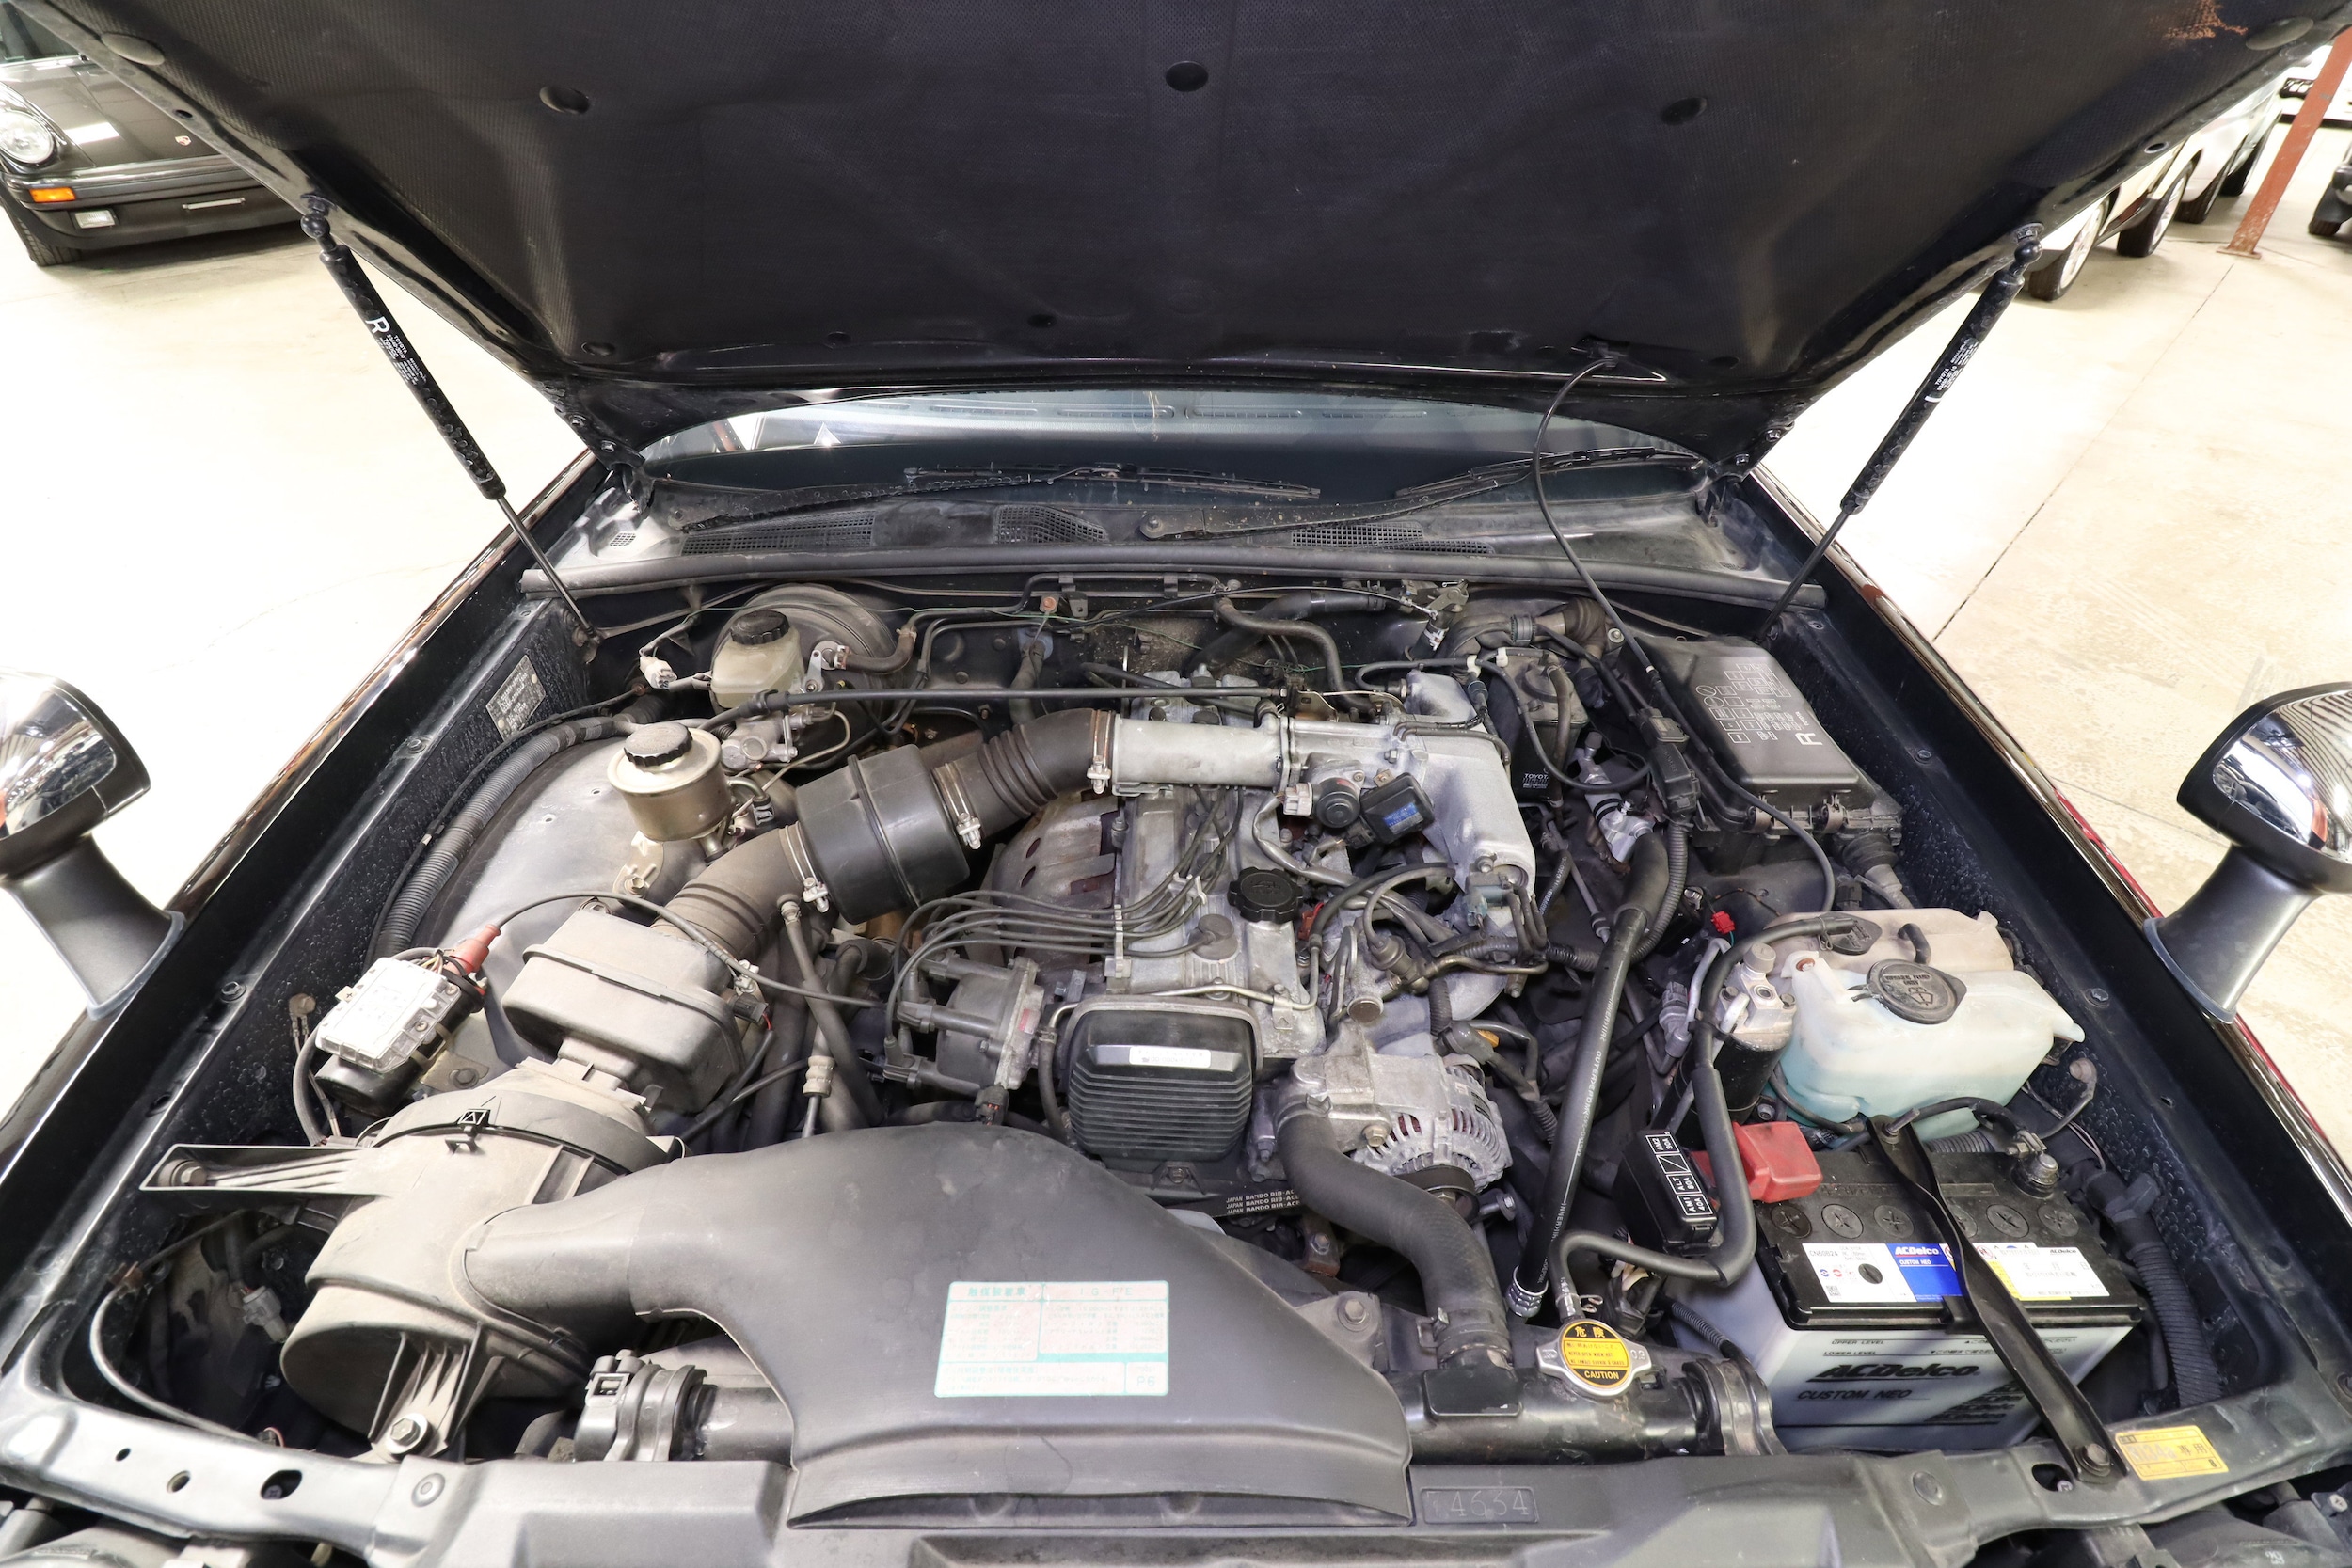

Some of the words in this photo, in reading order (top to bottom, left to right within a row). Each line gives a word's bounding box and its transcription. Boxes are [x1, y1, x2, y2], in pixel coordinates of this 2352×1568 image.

[365, 316, 390, 334] R
[394, 335, 407, 354] TOYOTA
[1934, 368, 1949, 385] TOYOTA
[1794, 732, 1823, 746] R
[1652, 1137, 1664, 1150] AM2
[1662, 1138, 1673, 1149] 30A
[1672, 1177, 1685, 1191] ALT
[1246, 1198, 1269, 1207] BANDO
[1246, 1204, 1270, 1212] BANDO
[1683, 1197, 1696, 1212] AM1
[1694, 1197, 1705, 1211] 40A
[1895, 1246, 1940, 1255] ACDelco
[1574, 1326, 1606, 1338] 危険
[1583, 1370, 1620, 1380] CAUTION
[1815, 1363, 1979, 1378] ACDelco
[1798, 1390, 1870, 1400] CUSTOM
[1875, 1389, 1913, 1399] NEO
